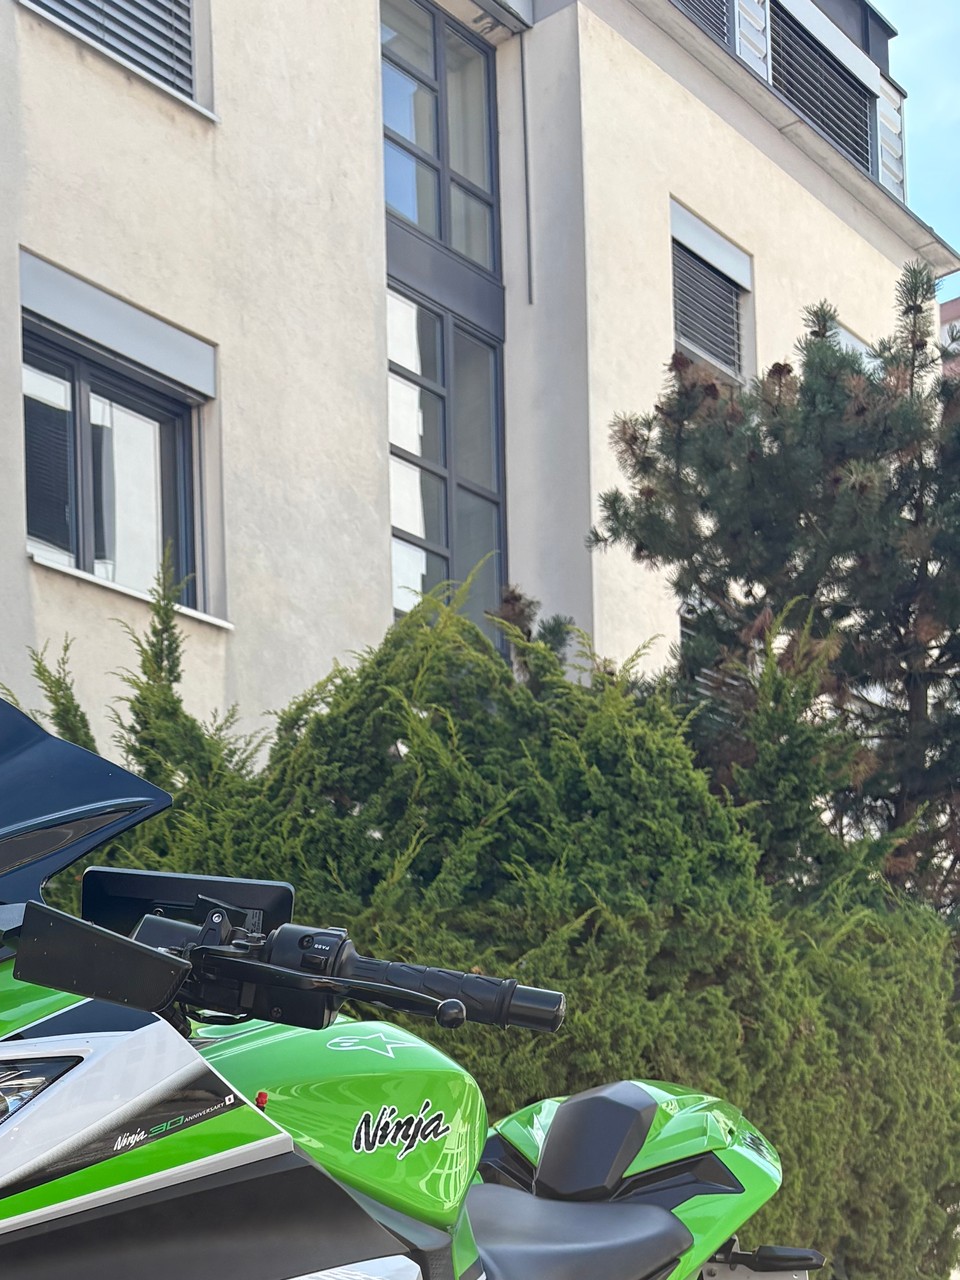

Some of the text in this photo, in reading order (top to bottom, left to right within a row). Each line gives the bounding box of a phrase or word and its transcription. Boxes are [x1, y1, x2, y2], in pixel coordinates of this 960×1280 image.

[113, 1101, 225, 1151] Ninja 30 ANNIVERSARY
[352, 1099, 450, 1161] Ninja
